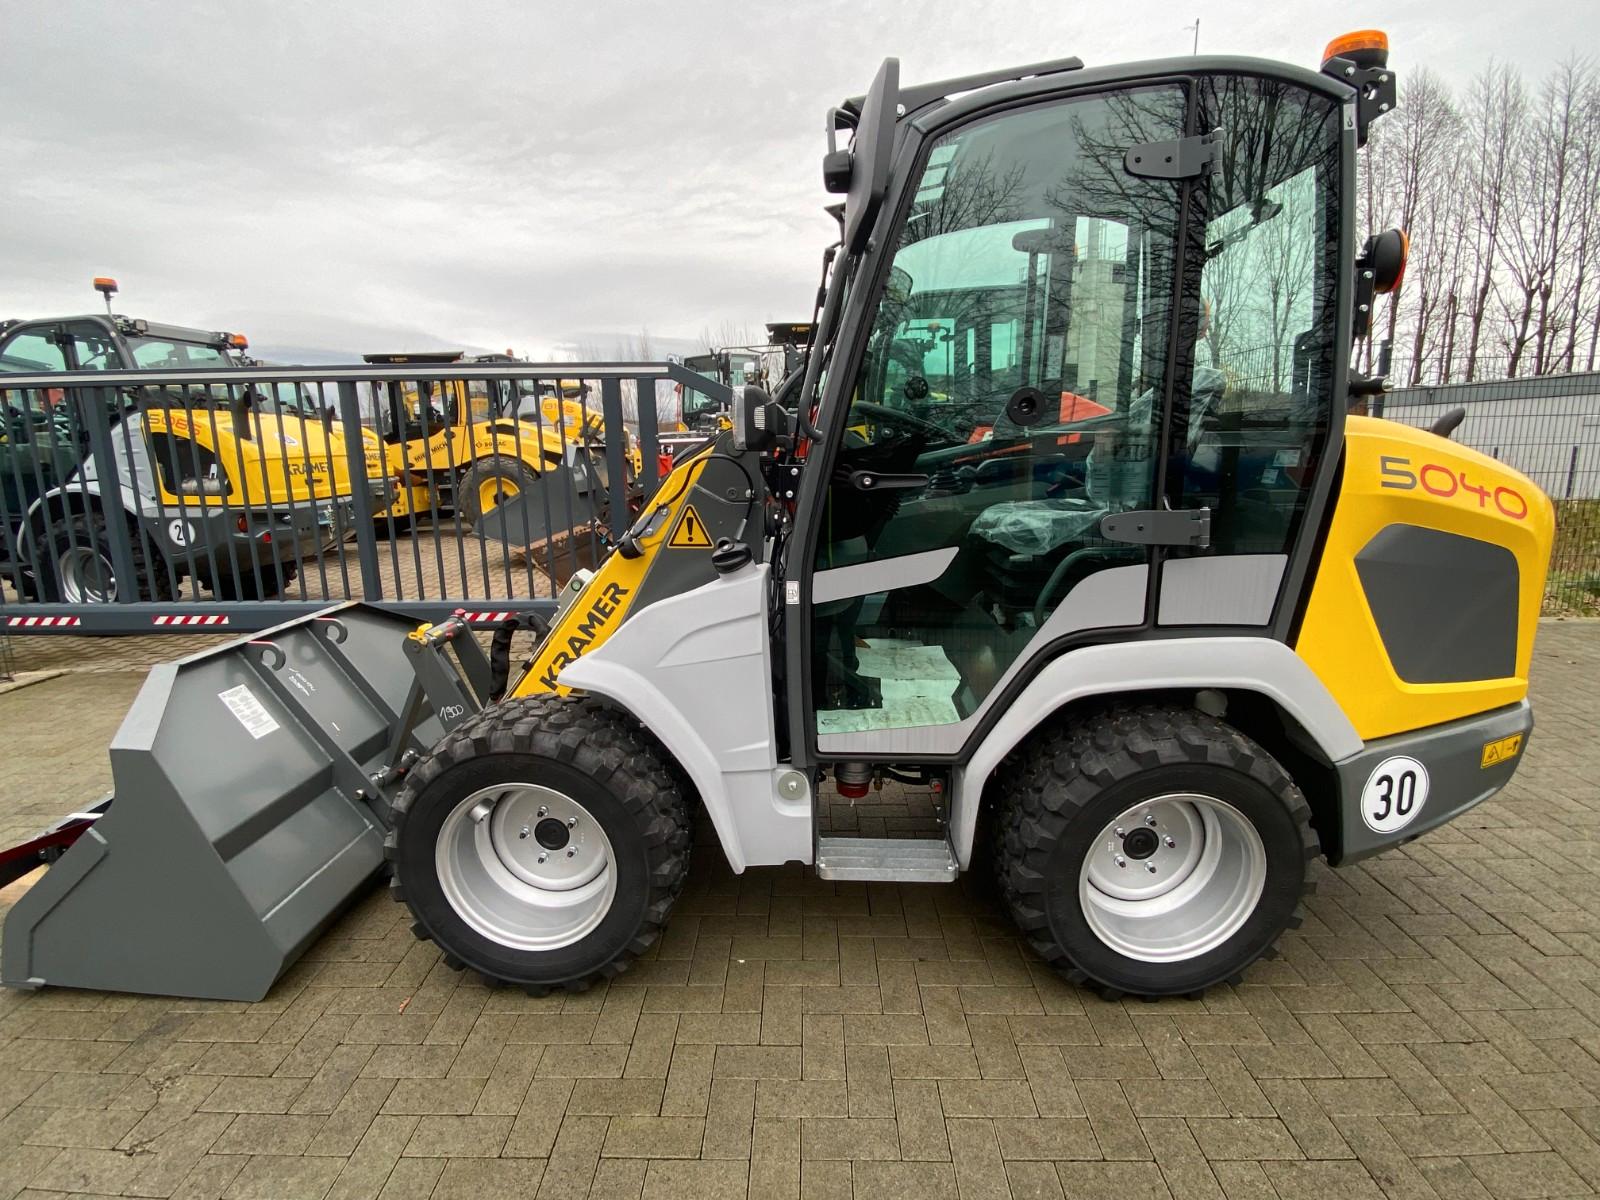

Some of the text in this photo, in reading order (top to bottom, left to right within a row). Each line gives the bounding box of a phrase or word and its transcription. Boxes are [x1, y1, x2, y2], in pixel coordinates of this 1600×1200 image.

[282, 461, 332, 477] KRAME
[1380, 455, 1528, 520] 5040
[539, 582, 630, 692] KRAMER
[1373, 769, 1417, 821] 30
